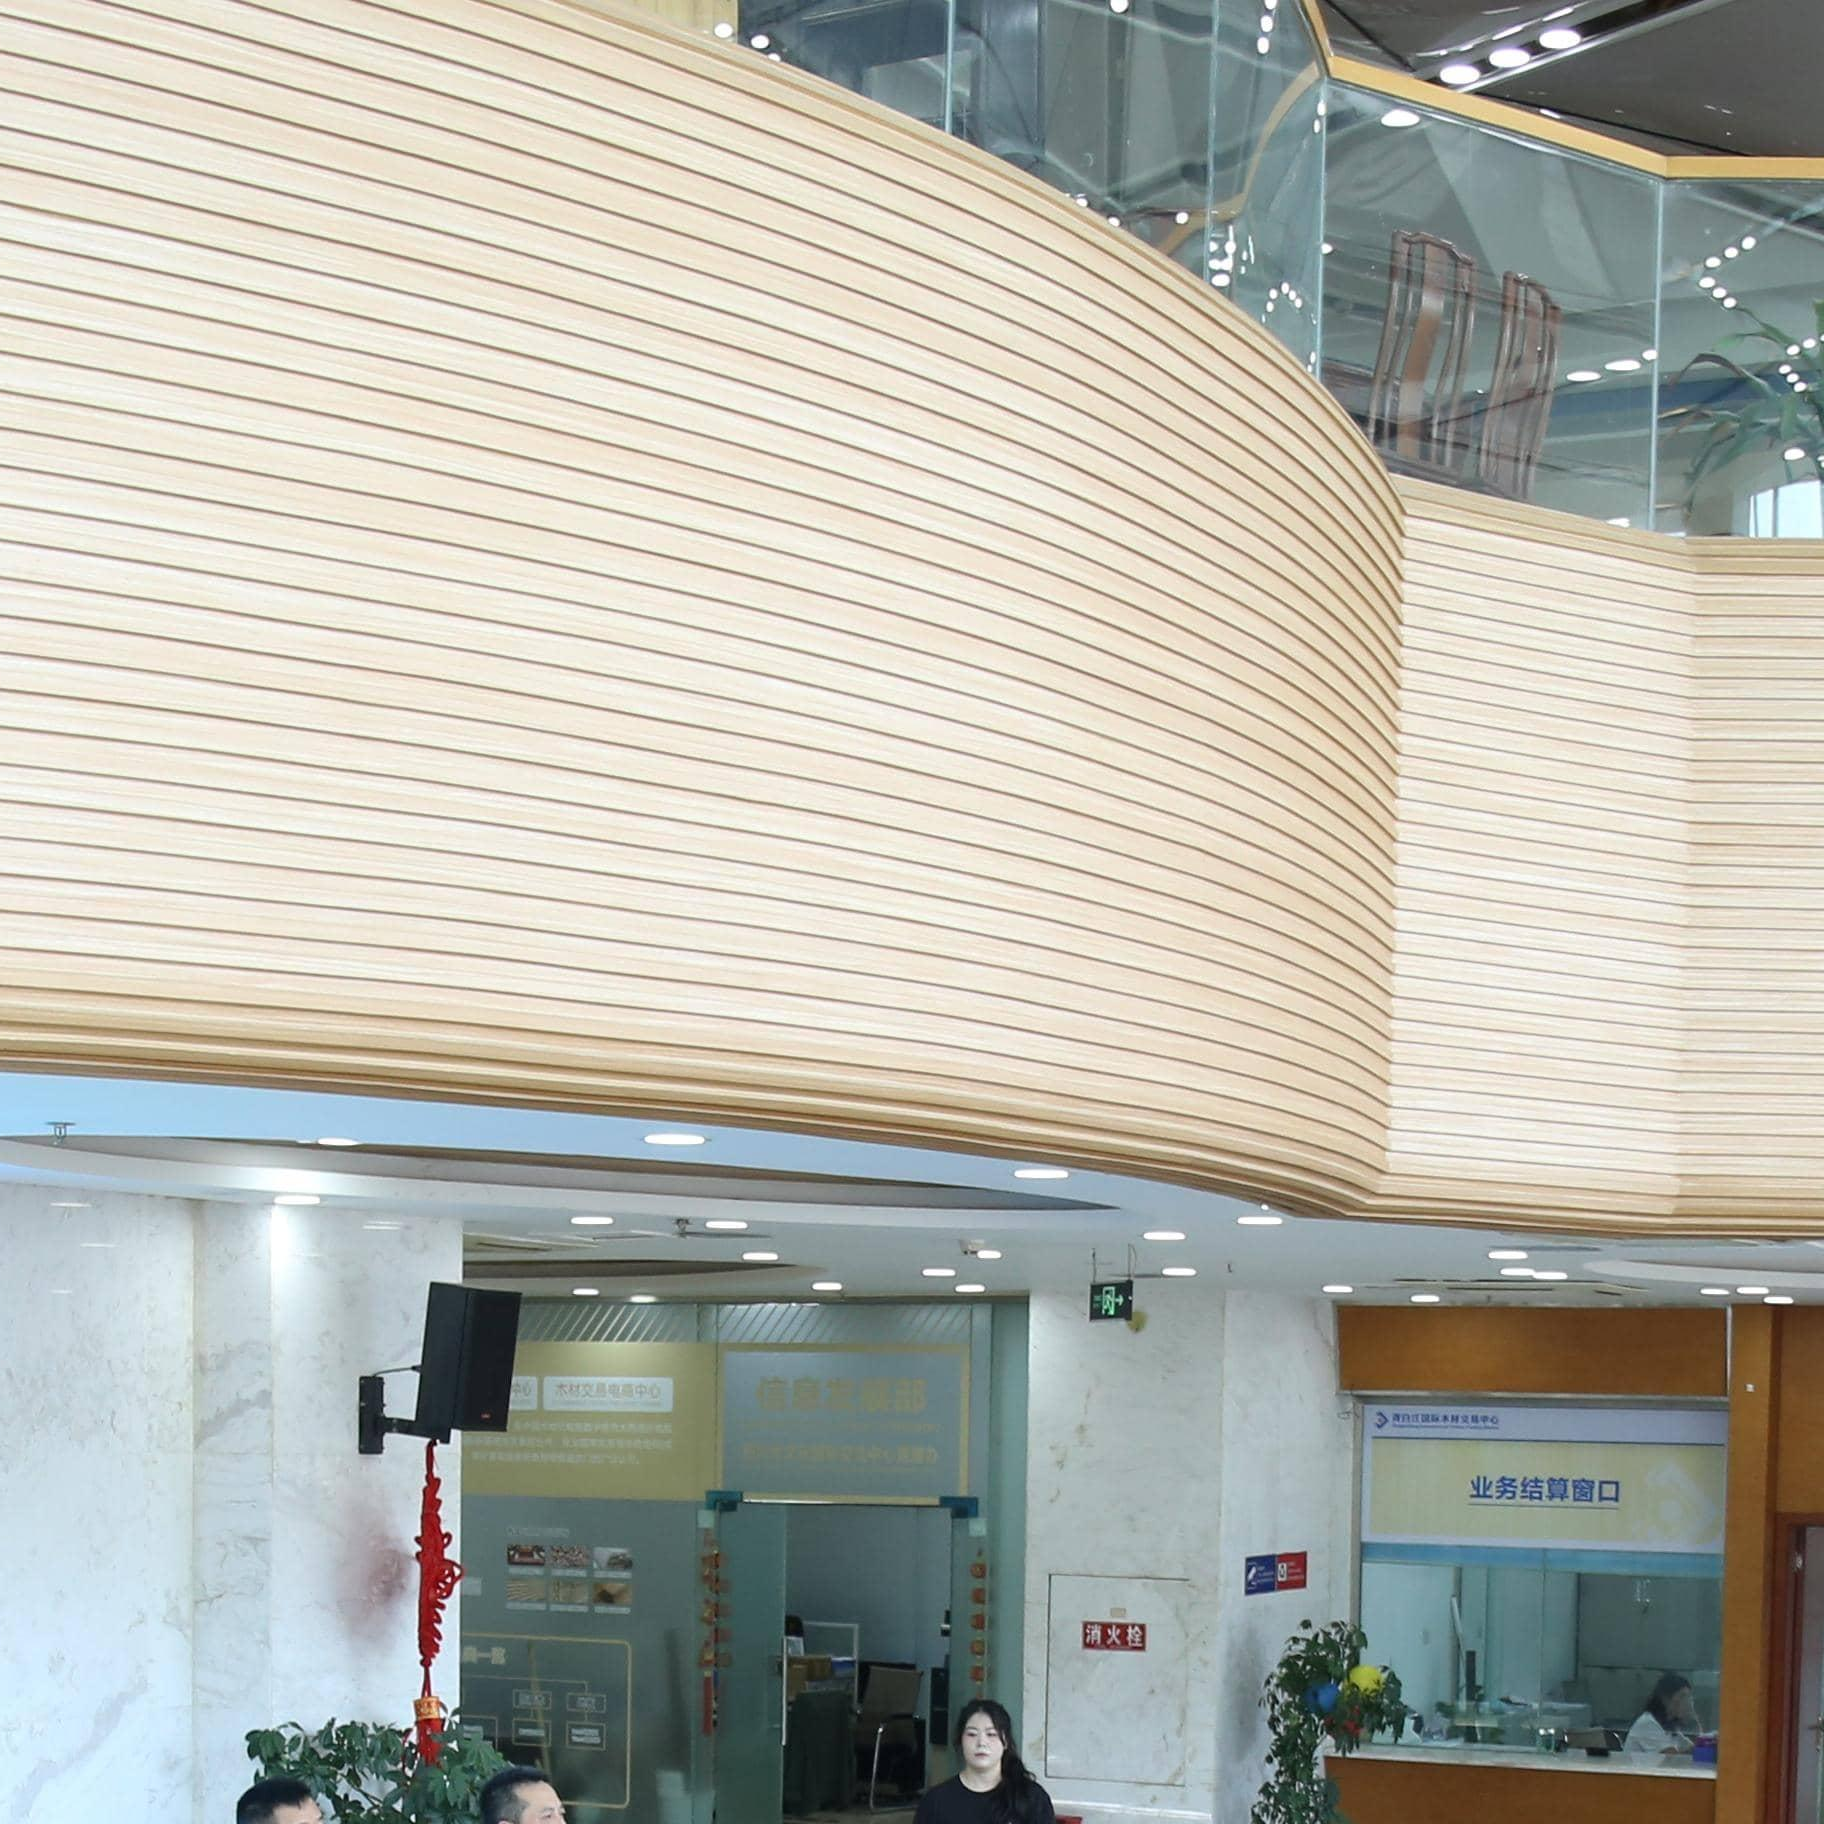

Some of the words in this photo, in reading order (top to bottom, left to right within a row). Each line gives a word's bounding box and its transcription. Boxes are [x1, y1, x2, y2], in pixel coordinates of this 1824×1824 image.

[1469, 1475, 1622, 1505] 业务结算窗口
[1085, 1623, 1143, 1648] 消火栓
